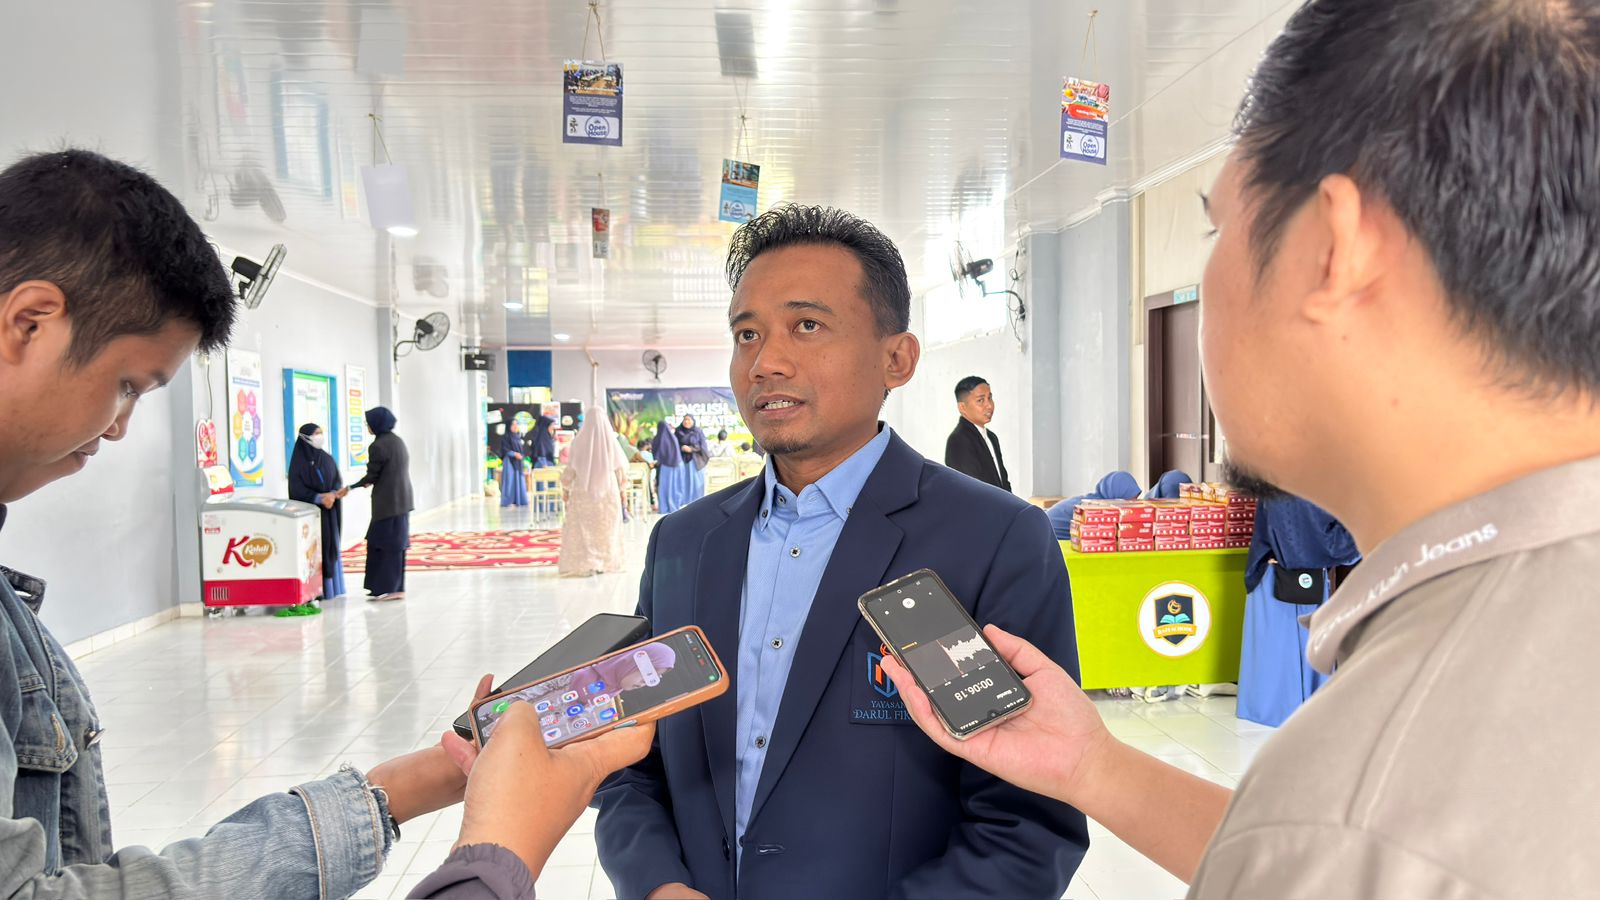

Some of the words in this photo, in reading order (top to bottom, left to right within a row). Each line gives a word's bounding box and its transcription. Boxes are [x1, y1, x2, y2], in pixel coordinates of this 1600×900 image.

[588, 124, 606, 132] Open
[1082, 141, 1097, 149] Open
[675, 403, 729, 416] ENGLISH
[954, 677, 994, 702] 00:06.18
[855, 709, 892, 719] DARUL
